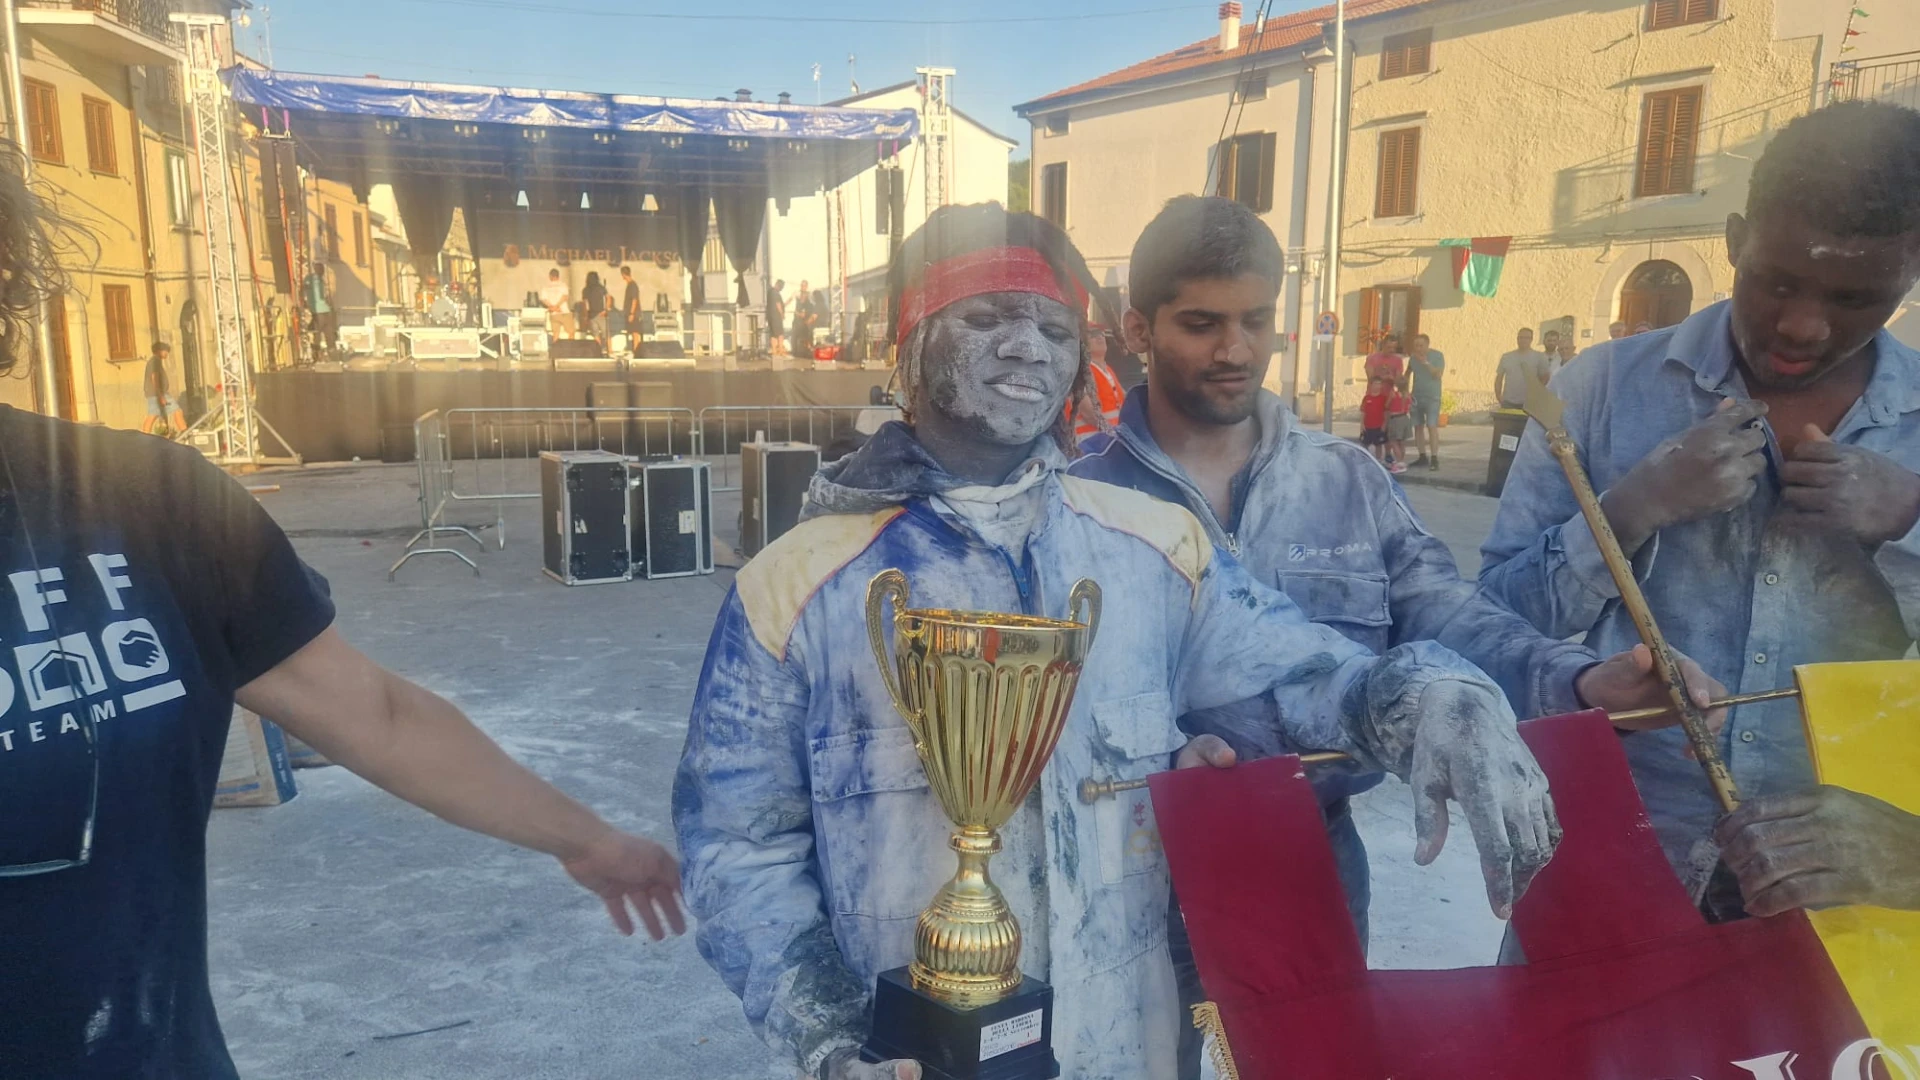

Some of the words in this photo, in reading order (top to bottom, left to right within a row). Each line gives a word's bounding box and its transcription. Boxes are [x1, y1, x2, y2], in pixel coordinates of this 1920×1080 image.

[528, 244, 616, 263] MICHAEL
[1306, 542, 1373, 558] PROMA
[0, 699, 117, 751] TEAM
